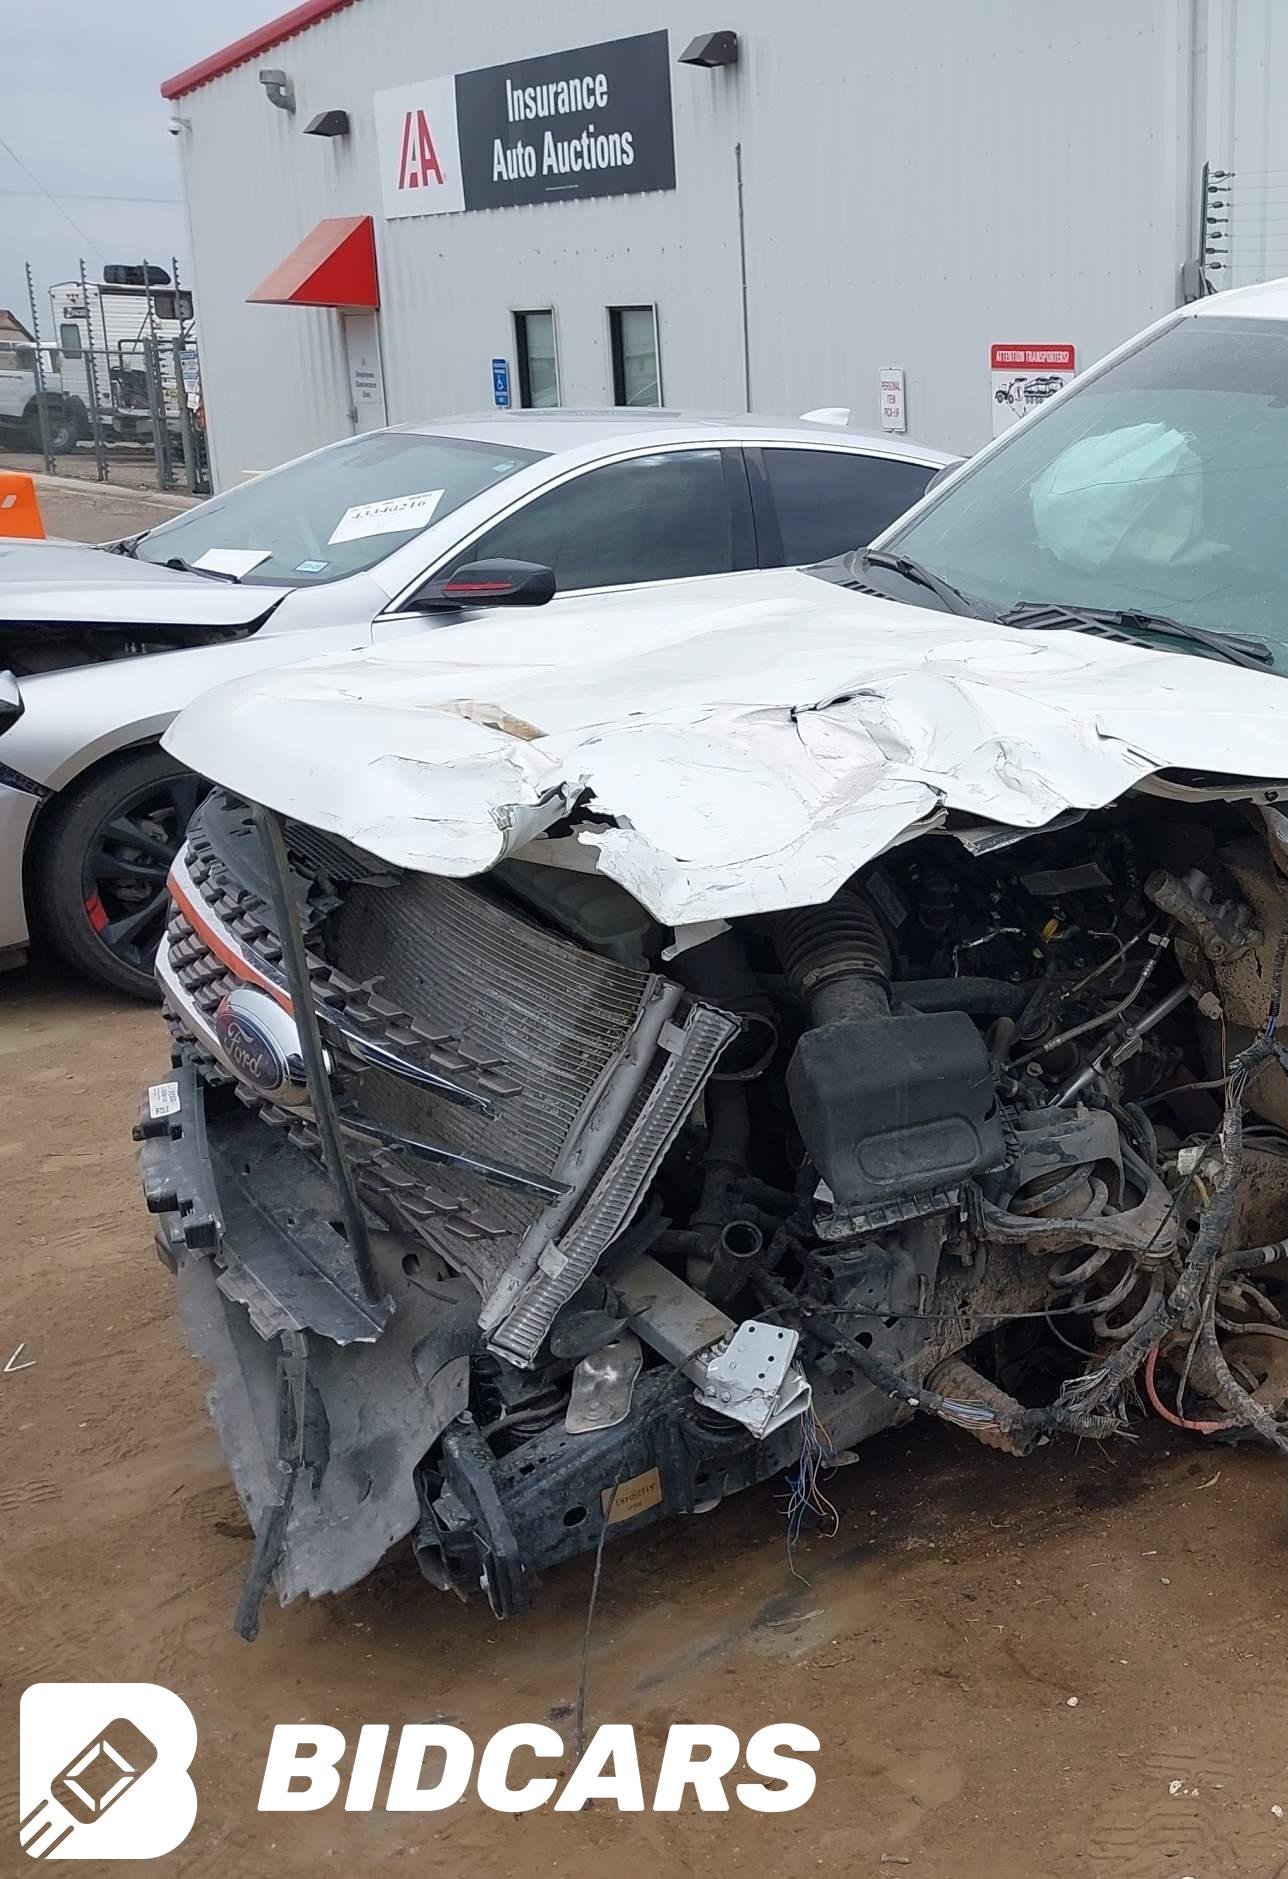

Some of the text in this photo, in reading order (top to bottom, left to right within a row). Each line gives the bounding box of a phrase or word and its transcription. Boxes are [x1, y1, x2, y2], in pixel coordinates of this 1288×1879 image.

[505, 73, 608, 122] Insurance
[492, 124, 634, 182] Auto Auctions
[223, 1022, 263, 1078] Ford
